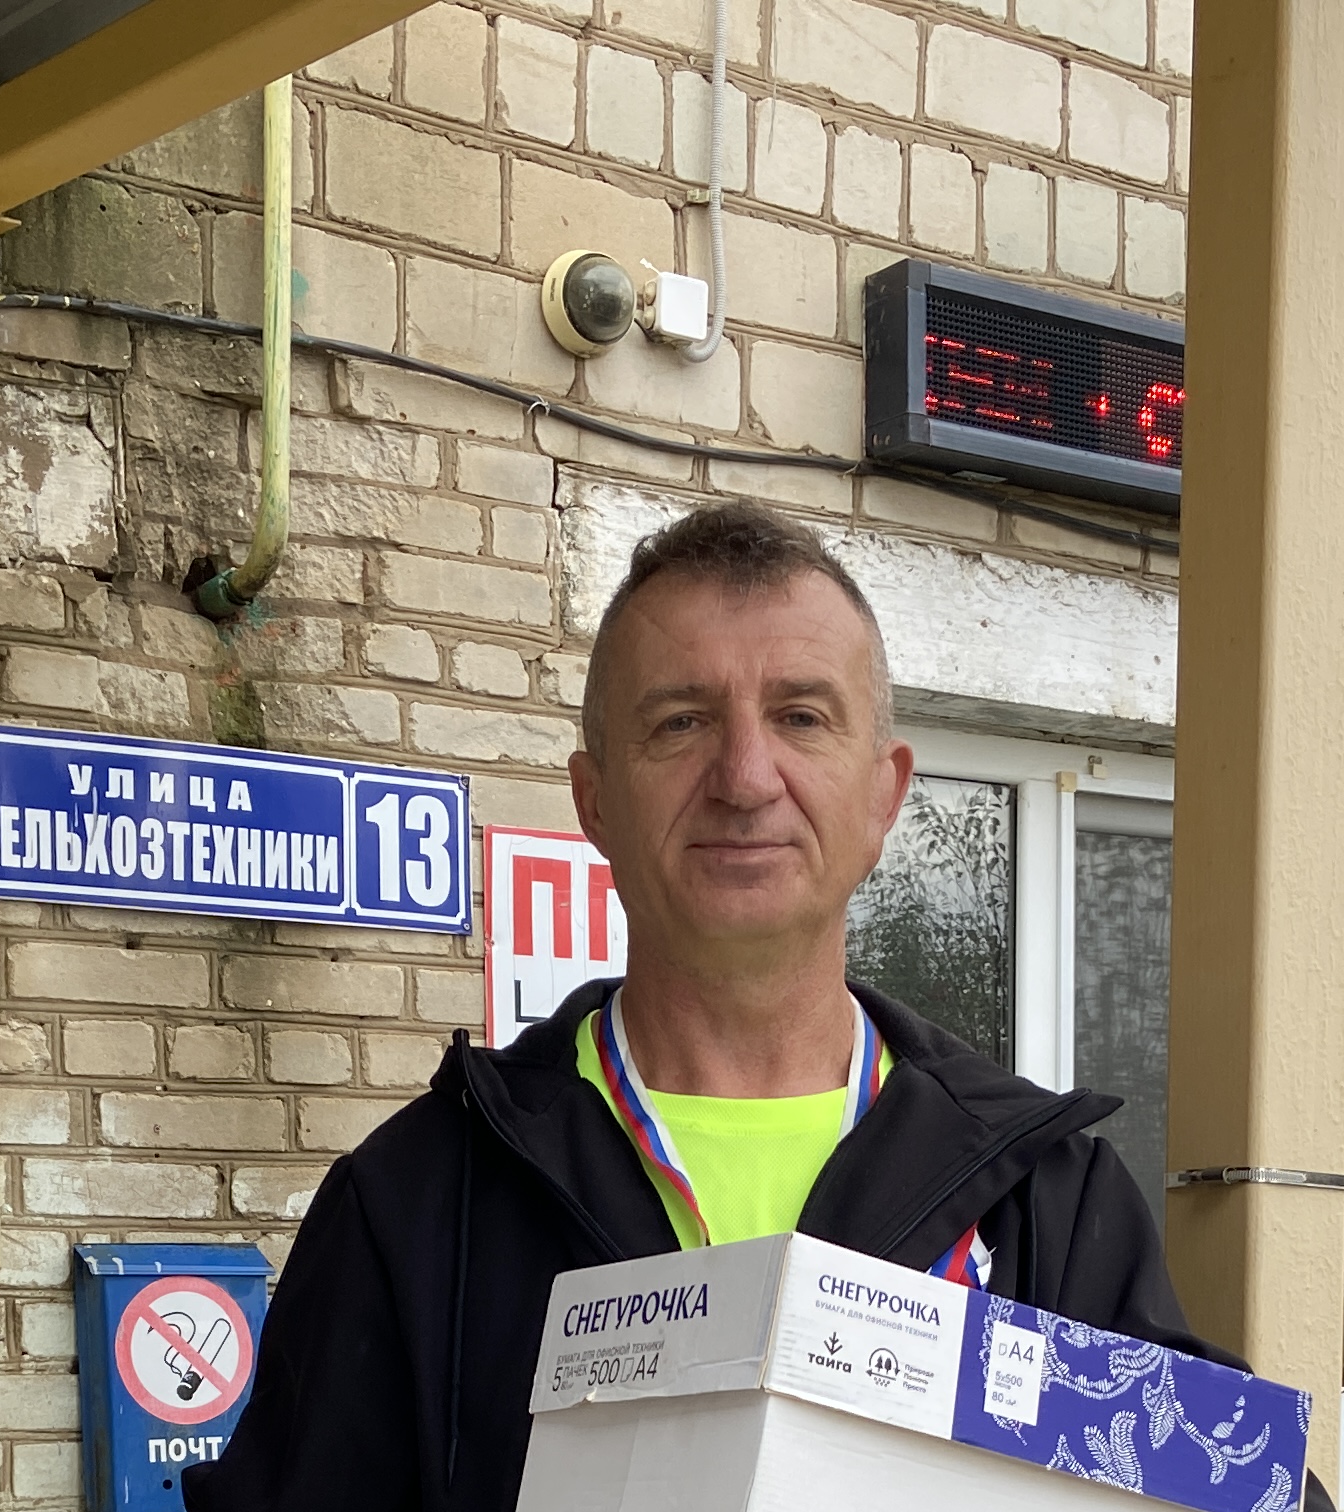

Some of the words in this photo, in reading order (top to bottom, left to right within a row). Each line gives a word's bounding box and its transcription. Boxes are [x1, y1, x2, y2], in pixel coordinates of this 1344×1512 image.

[67, 763, 252, 812] УЛИЦА
[365, 793, 451, 908] 13
[563, 1283, 708, 1337] СНЕГУРОЧКА
[818, 1274, 941, 1326] СНЕГУРОЧКА
[587, 1357, 621, 1386] 500
[148, 1435, 231, 1463] ПОЧТ
